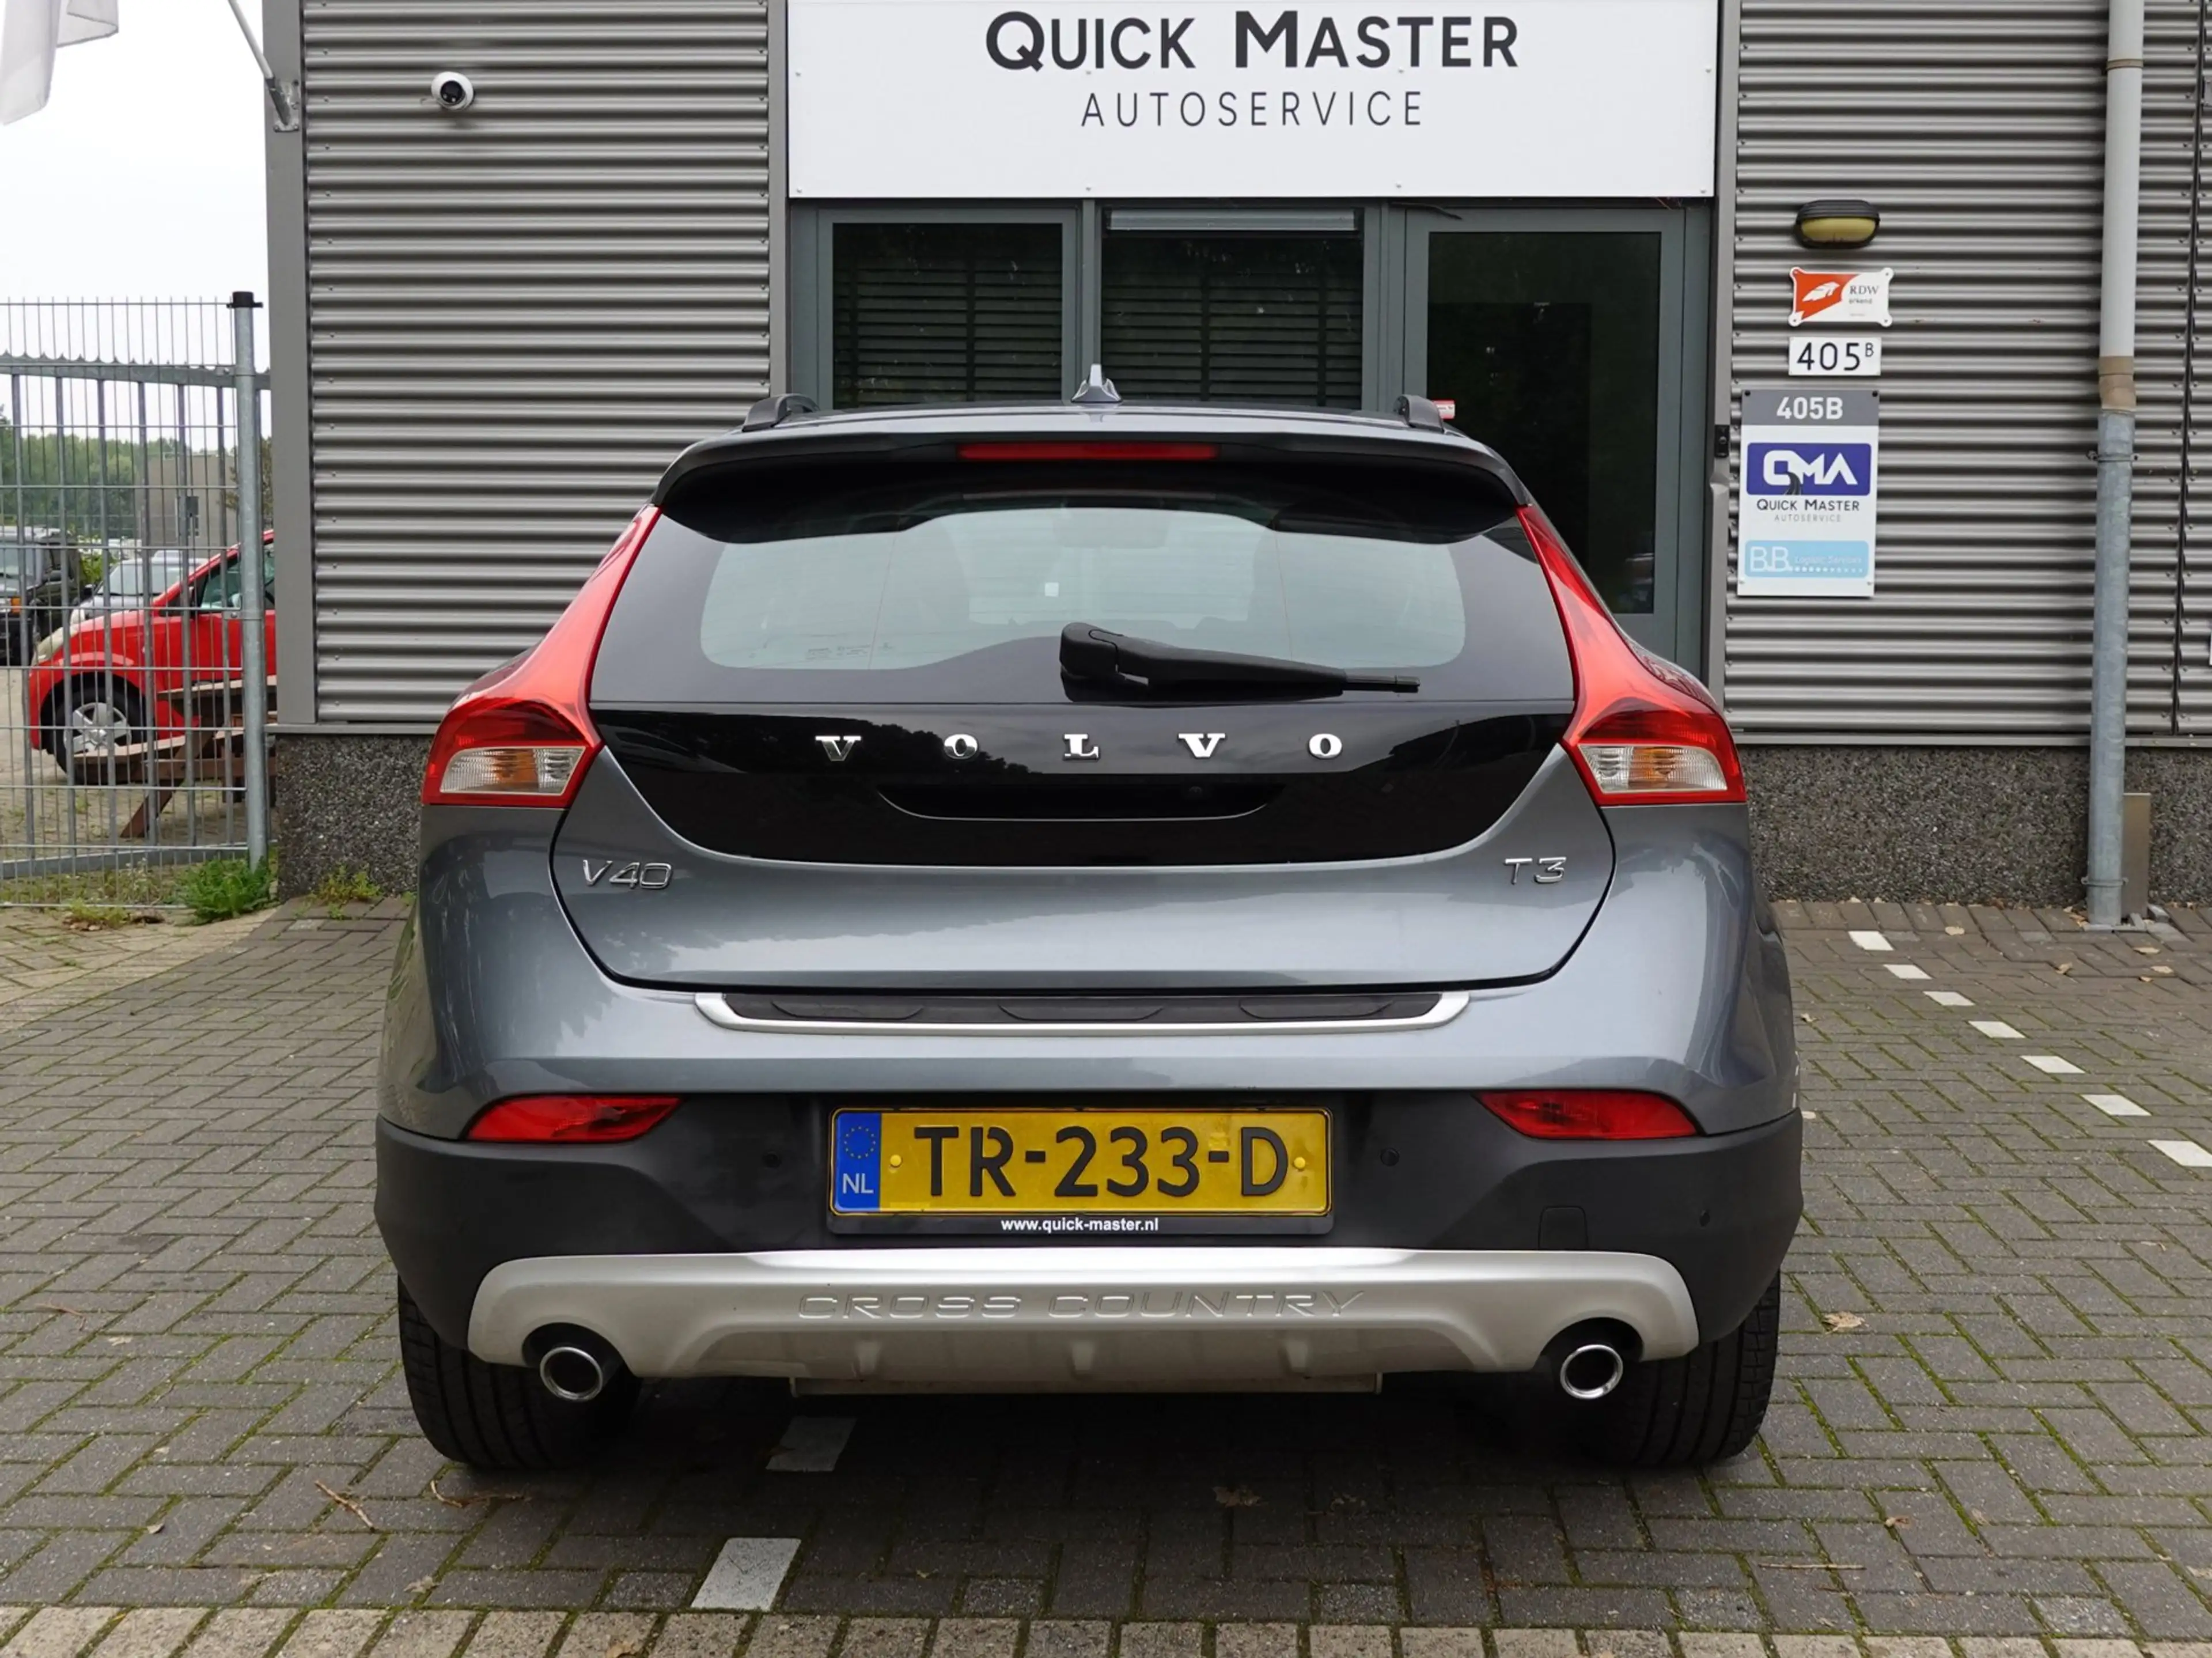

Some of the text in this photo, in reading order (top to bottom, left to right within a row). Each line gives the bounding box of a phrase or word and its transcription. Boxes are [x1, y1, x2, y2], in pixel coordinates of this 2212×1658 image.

[986, 10, 1518, 72] QUICK MASTER
[1081, 90, 1422, 127] AUTOSERVICE
[1849, 285, 1880, 295] RDW
[1776, 396, 1843, 420] 405B
[1756, 498, 1860, 512] QUICK MASTER
[1774, 514, 1842, 523] AUTOSERVICE
[815, 732, 1343, 762] VOLVO
[582, 859, 672, 889] V40
[1504, 856, 1567, 885] T3
[914, 1125, 1289, 1198] TR-233-D
[842, 1173, 874, 1195] NL
[1001, 1217, 1159, 1234] www.quick-master.nl
[798, 1290, 1365, 1319] CROSS COUNTRY
